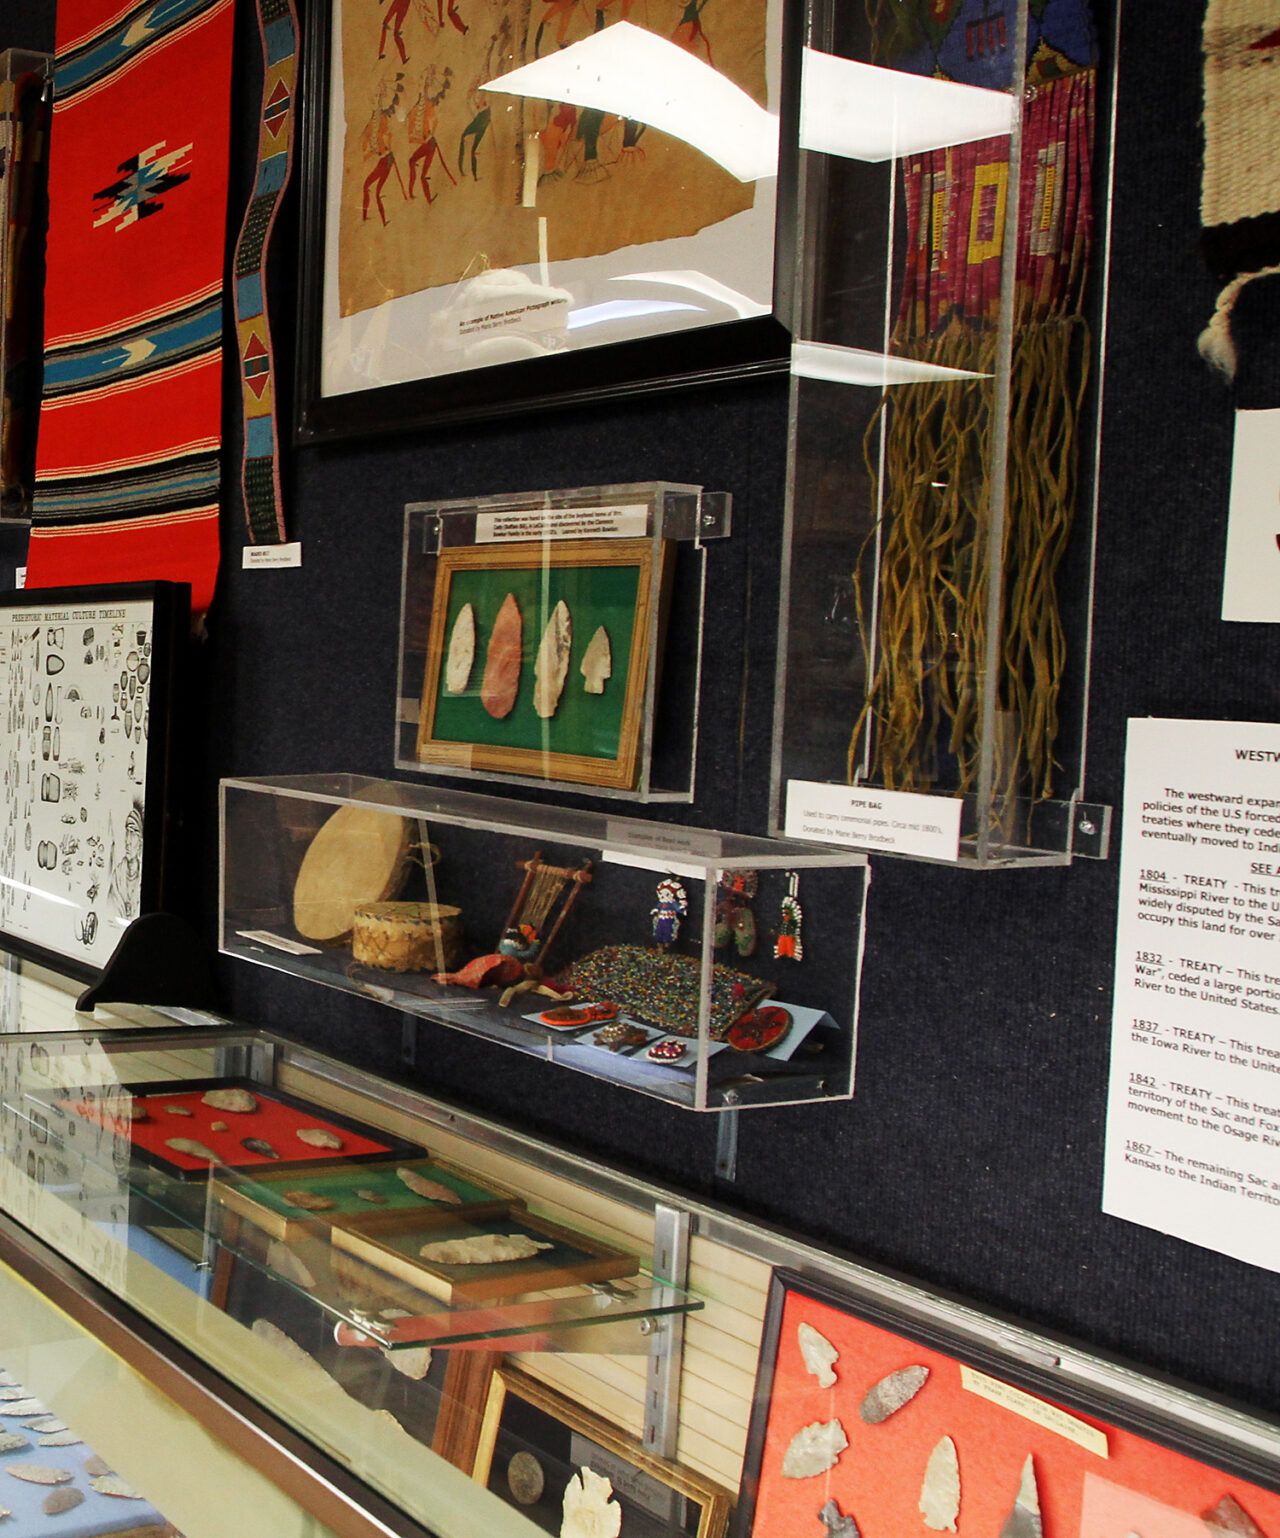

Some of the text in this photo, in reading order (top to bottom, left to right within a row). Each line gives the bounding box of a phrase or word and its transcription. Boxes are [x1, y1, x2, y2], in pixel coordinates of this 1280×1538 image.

[851, 799, 883, 810] PIPE BAG
[1142, 801, 1183, 813] policies
[1186, 805, 1198, 814] of
[1200, 807, 1219, 816] the
[1222, 809, 1242, 819] U.S
[1165, 788, 1185, 799] The
[1187, 791, 1243, 804] westward
[1142, 814, 1183, 827] treaties
[1186, 820, 1221, 831] where
[1225, 824, 1250, 837] they
[1141, 830, 1197, 845] eventually
[1200, 836, 1238, 848] moved
[1242, 840, 1254, 850] to
[1140, 868, 1167, 882] 1804
[1183, 874, 1227, 889] TREATY
[1242, 882, 1266, 895] This
[1250, 862, 1272, 875] SEE
[1139, 882, 1197, 900] Mississippi
[1200, 891, 1229, 904] River
[1233, 896, 1245, 906] to
[1248, 898, 1267, 910] the
[1138, 897, 1173, 912] widely
[1175, 902, 1224, 918] disputed
[1227, 909, 1241, 922] by
[1244, 913, 1264, 924] the
[1137, 912, 1275, 940] occupy this land for over
[1135, 950, 1162, 964] 1832
[1179, 958, 1223, 974] TREATY
[1237, 968, 1260, 982] This
[1134, 978, 1162, 992] River
[1165, 984, 1176, 995] to
[1179, 987, 1197, 999] the
[1200, 991, 1237, 1007] United
[1168, 971, 1200, 985] ceded
[1203, 979, 1210, 987] a
[1213, 979, 1243, 994] large
[1131, 1032, 1149, 1044] the
[1151, 1036, 1179, 1051] Iowa
[1182, 1043, 1211, 1058] River
[1214, 1051, 1226, 1061] to
[1229, 1054, 1248, 1066] the
[1132, 1018, 1159, 1032] 1837
[1172, 1026, 1215, 1044] TREATY
[1229, 1038, 1253, 1053] This
[1129, 1072, 1156, 1087] 1842
[1169, 1081, 1212, 1100] TREATY
[1226, 1095, 1249, 1110] This
[1128, 1086, 1172, 1106] territory
[1175, 1099, 1187, 1107] of
[1189, 1102, 1208, 1114] the
[1211, 1107, 1231, 1120] Sac
[1233, 1113, 1255, 1126] and
[1127, 1101, 1184, 1122] movement
[1187, 1115, 1198, 1126] to
[1201, 1118, 1220, 1131] the
[1223, 1124, 1259, 1142] Osage
[1124, 1153, 1162, 1172] Kansas
[1164, 1165, 1175, 1175] to
[1178, 1169, 1197, 1182] the
[1200, 1174, 1237, 1193] Indian
[1125, 1140, 1269, 1187] 1867 The remaining Sac
